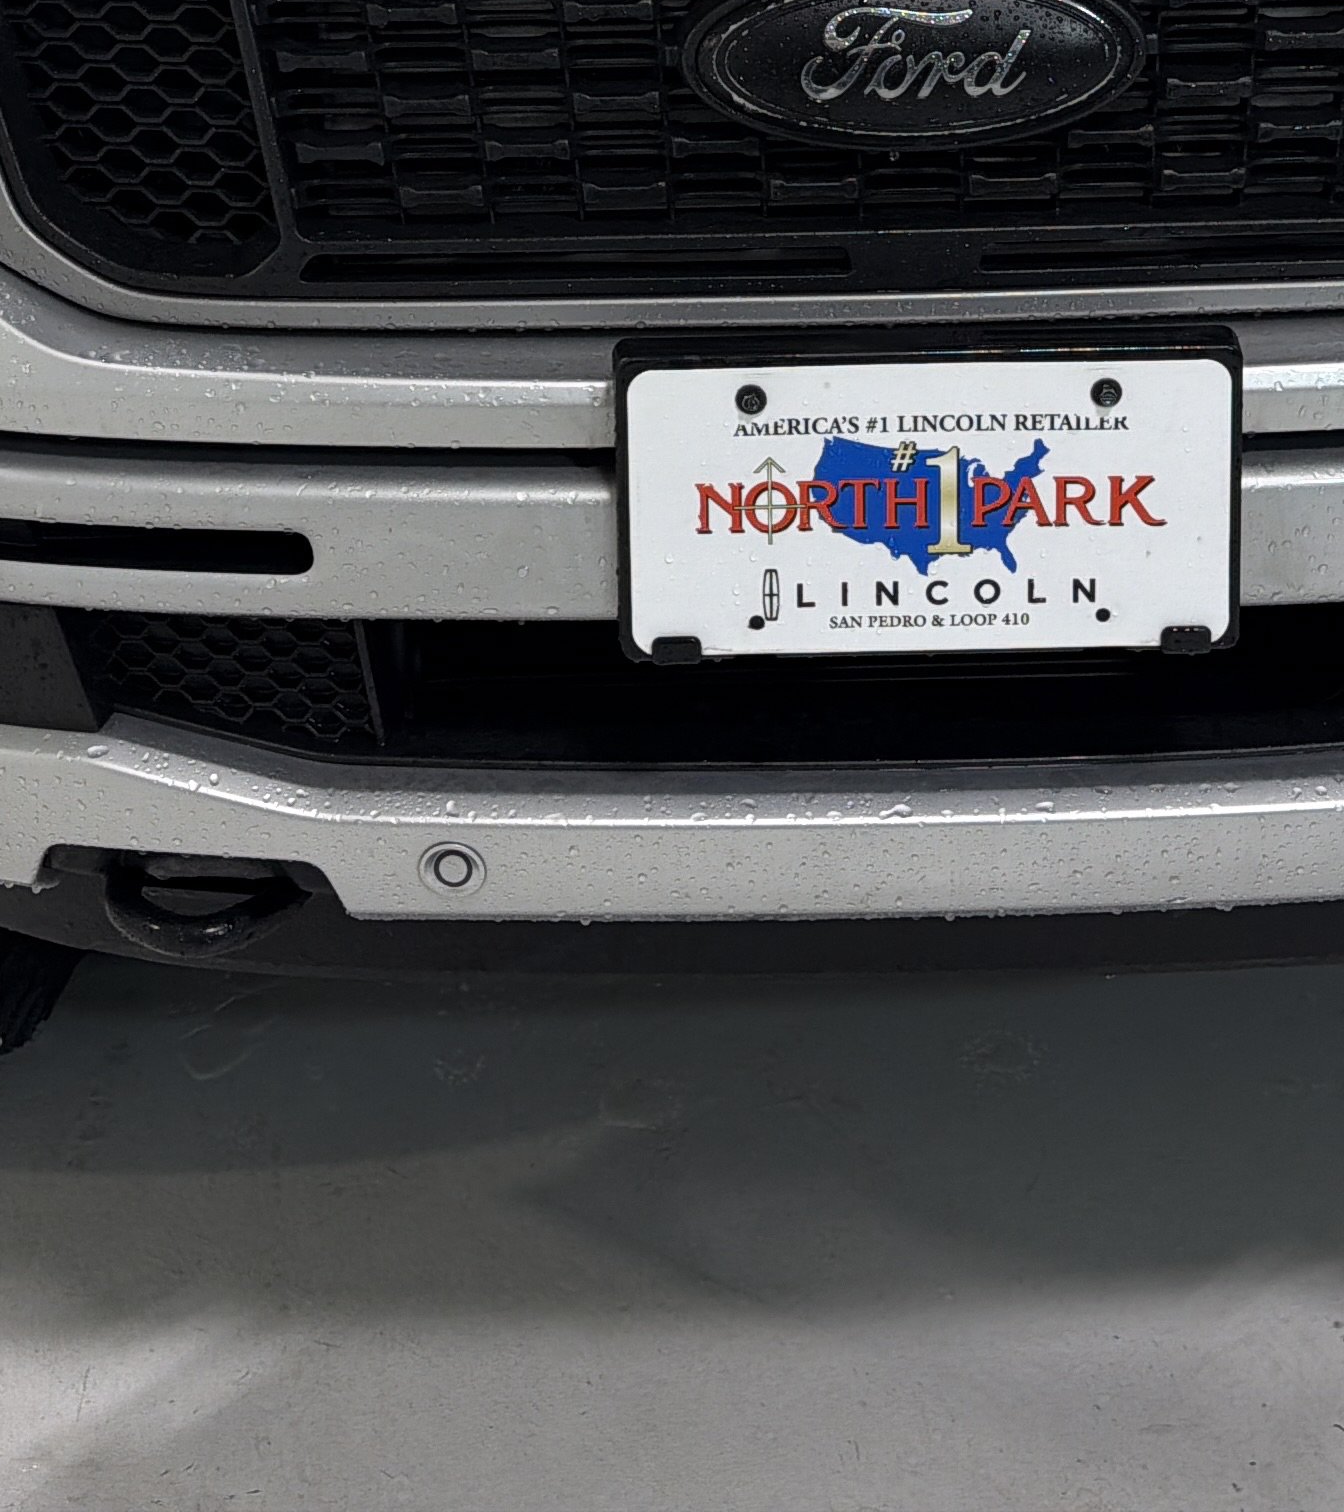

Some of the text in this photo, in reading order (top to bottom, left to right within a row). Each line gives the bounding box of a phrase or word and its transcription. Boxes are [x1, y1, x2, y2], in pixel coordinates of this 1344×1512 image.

[800, 5, 1032, 101] Ford
[733, 413, 1130, 437] AMERICA'S #1 LINCOLN RETAILER
[695, 475, 1168, 534] NORTH PARK
[796, 578, 1097, 609] LINCOLN
[828, 612, 1030, 629] SAN PEDRO & LOOP 410
